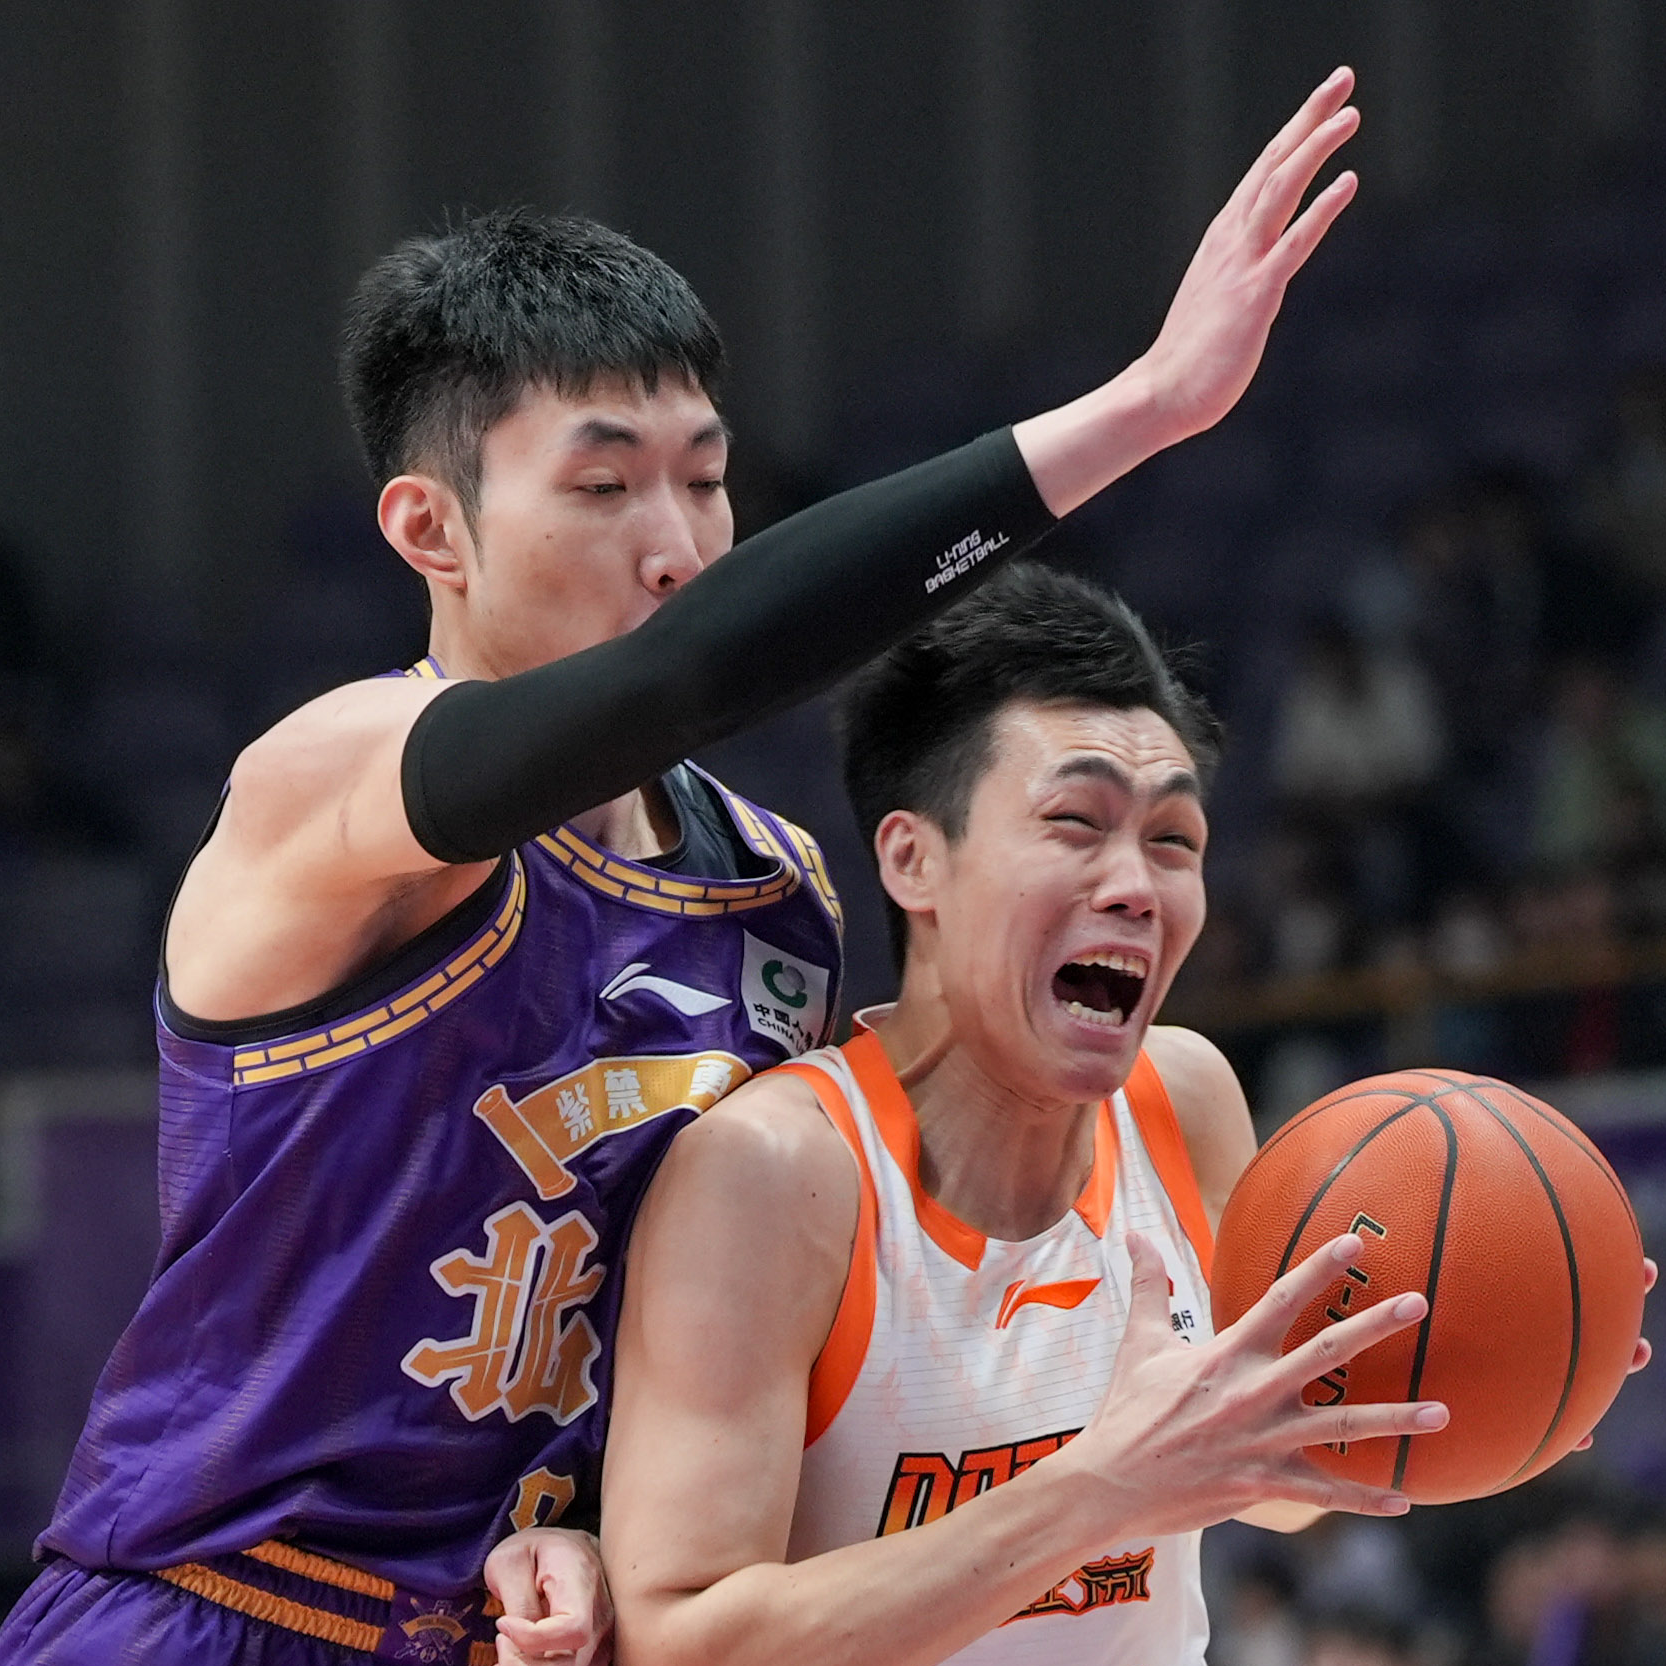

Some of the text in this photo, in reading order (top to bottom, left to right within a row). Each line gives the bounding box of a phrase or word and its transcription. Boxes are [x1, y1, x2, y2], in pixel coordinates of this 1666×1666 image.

[924, 531, 1010, 594] BASKETBALL
[935, 529, 982, 570] LI-NING
[757, 1017, 795, 1044] CHINA
[401, 1200, 607, 1427] 北
